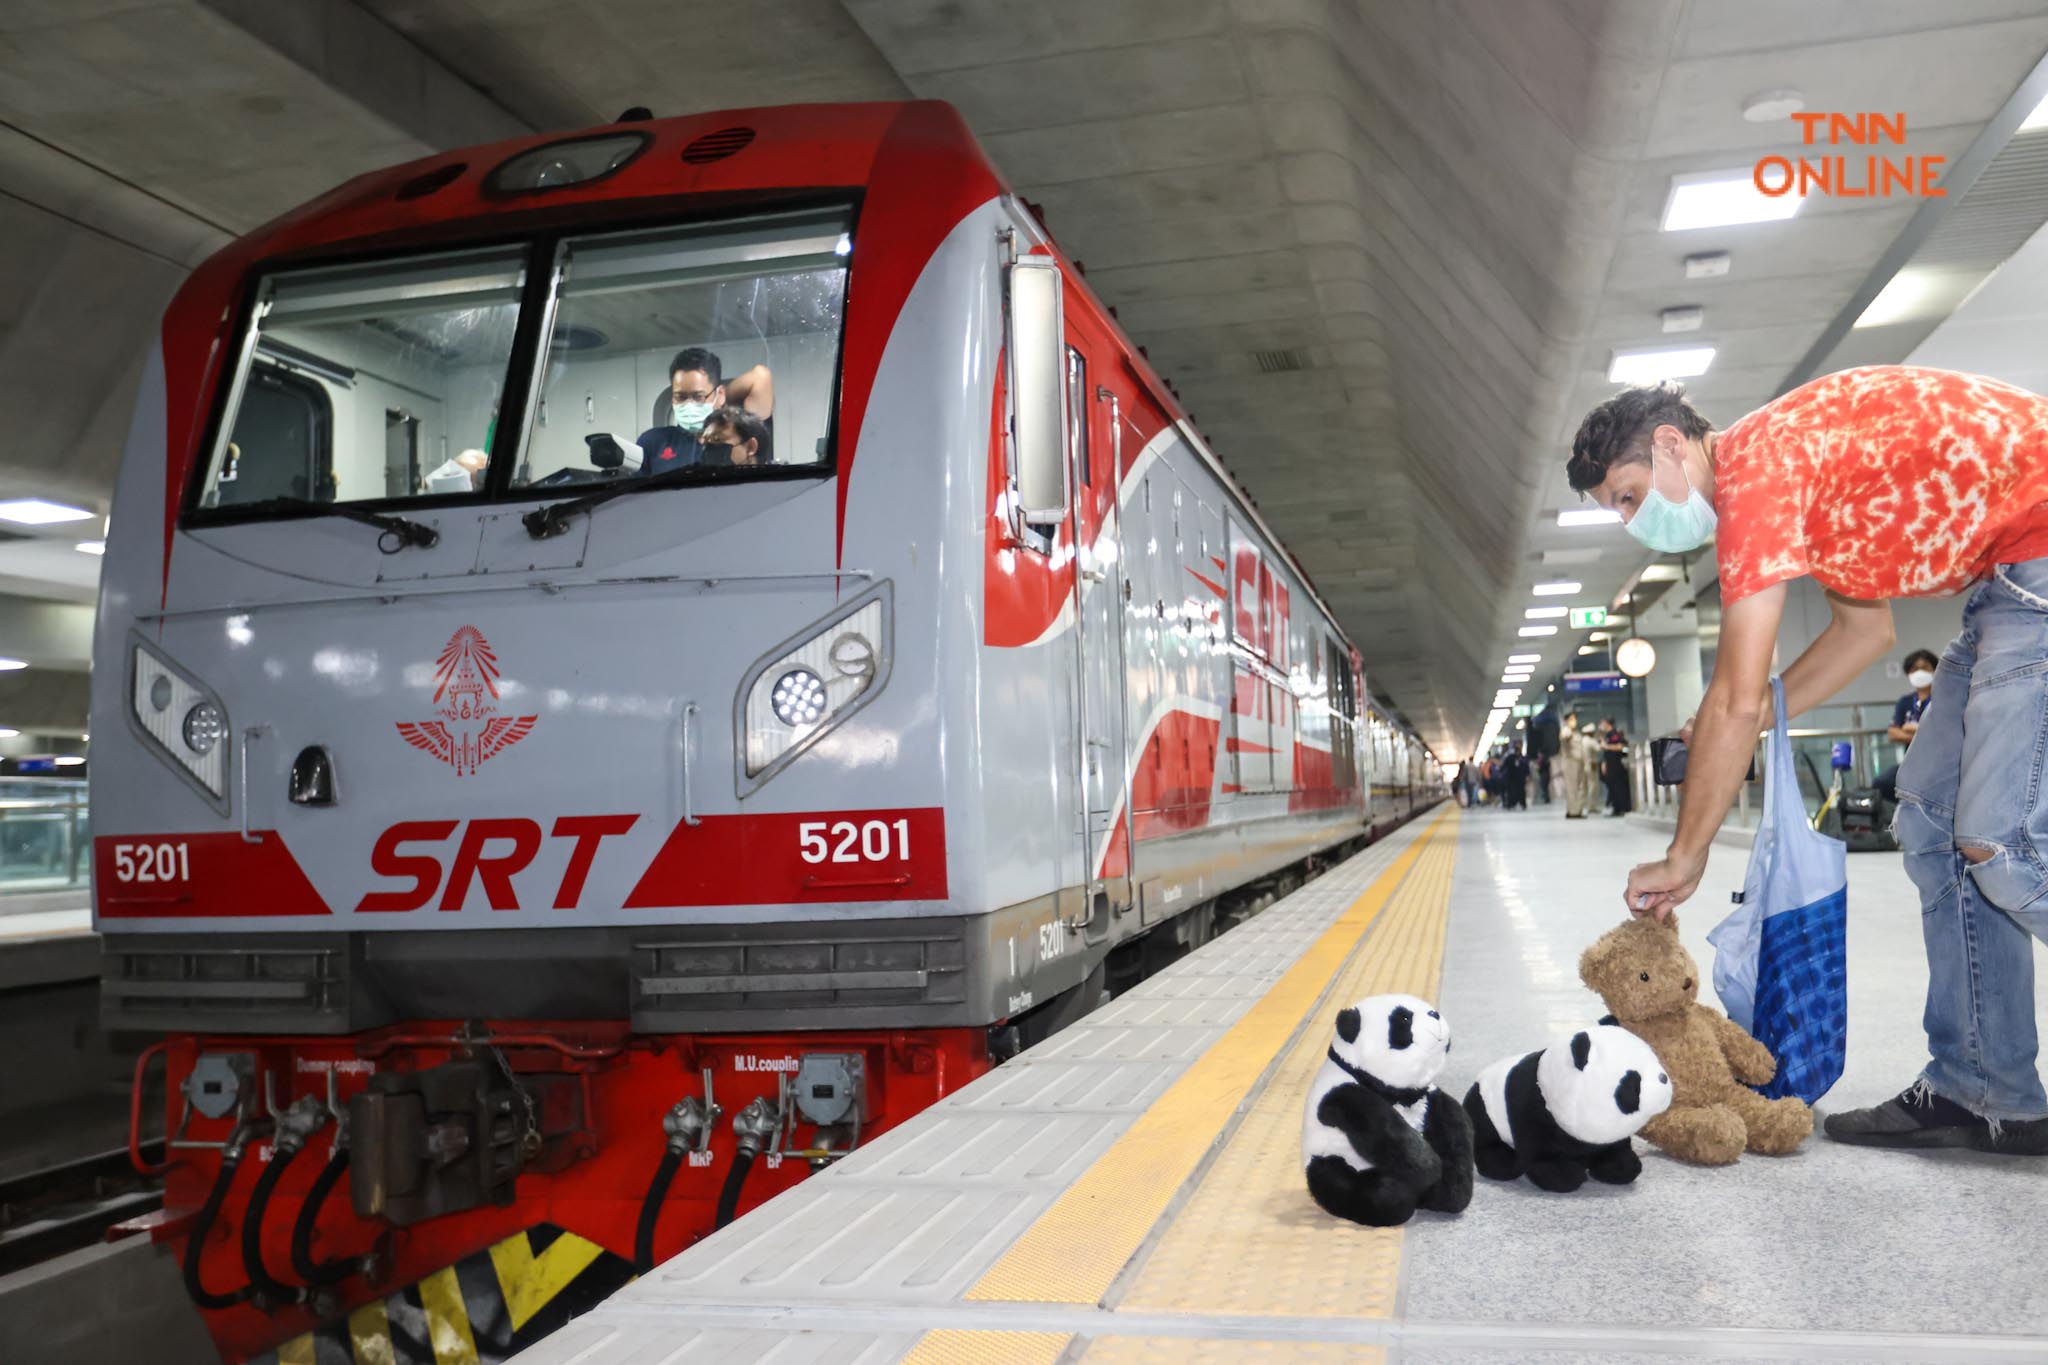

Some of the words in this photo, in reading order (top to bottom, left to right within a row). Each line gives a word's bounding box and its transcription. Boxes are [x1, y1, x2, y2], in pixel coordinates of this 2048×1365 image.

[799, 818, 909, 864] 5201
[115, 843, 190, 882] 5201
[353, 813, 641, 913] SRT
[1039, 919, 1064, 961] 5201
[734, 1055, 799, 1072] M.U.couplin
